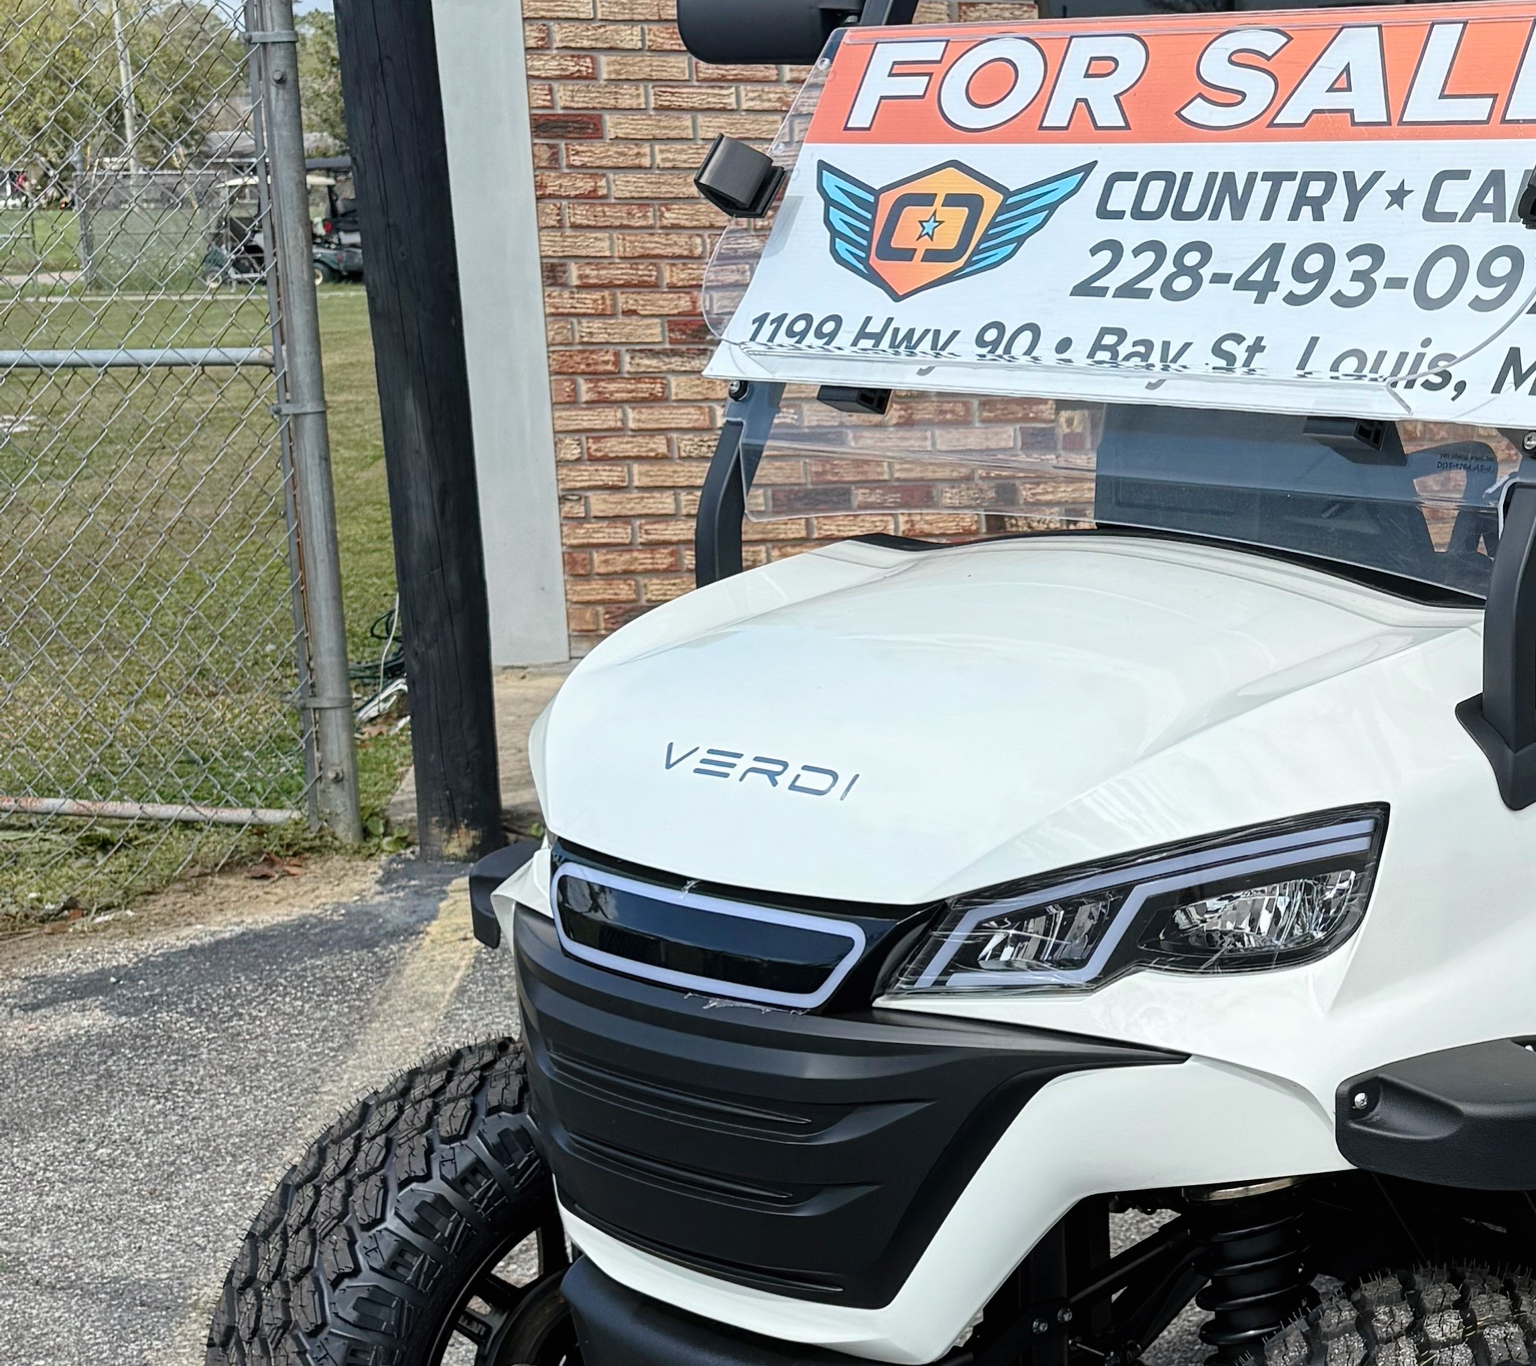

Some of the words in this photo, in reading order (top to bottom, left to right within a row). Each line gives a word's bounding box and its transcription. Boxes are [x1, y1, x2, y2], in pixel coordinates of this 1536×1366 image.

[843, 32, 1149, 133] FOR
[1096, 170, 1387, 222] COUNTRY
[749, 312, 844, 348] 1199
[849, 316, 962, 376] Hwy
[974, 320, 1043, 362] 90
[1086, 326, 1195, 390] Bay
[1295, 336, 1467, 402] Louis,
[664, 741, 860, 802] VERDI
